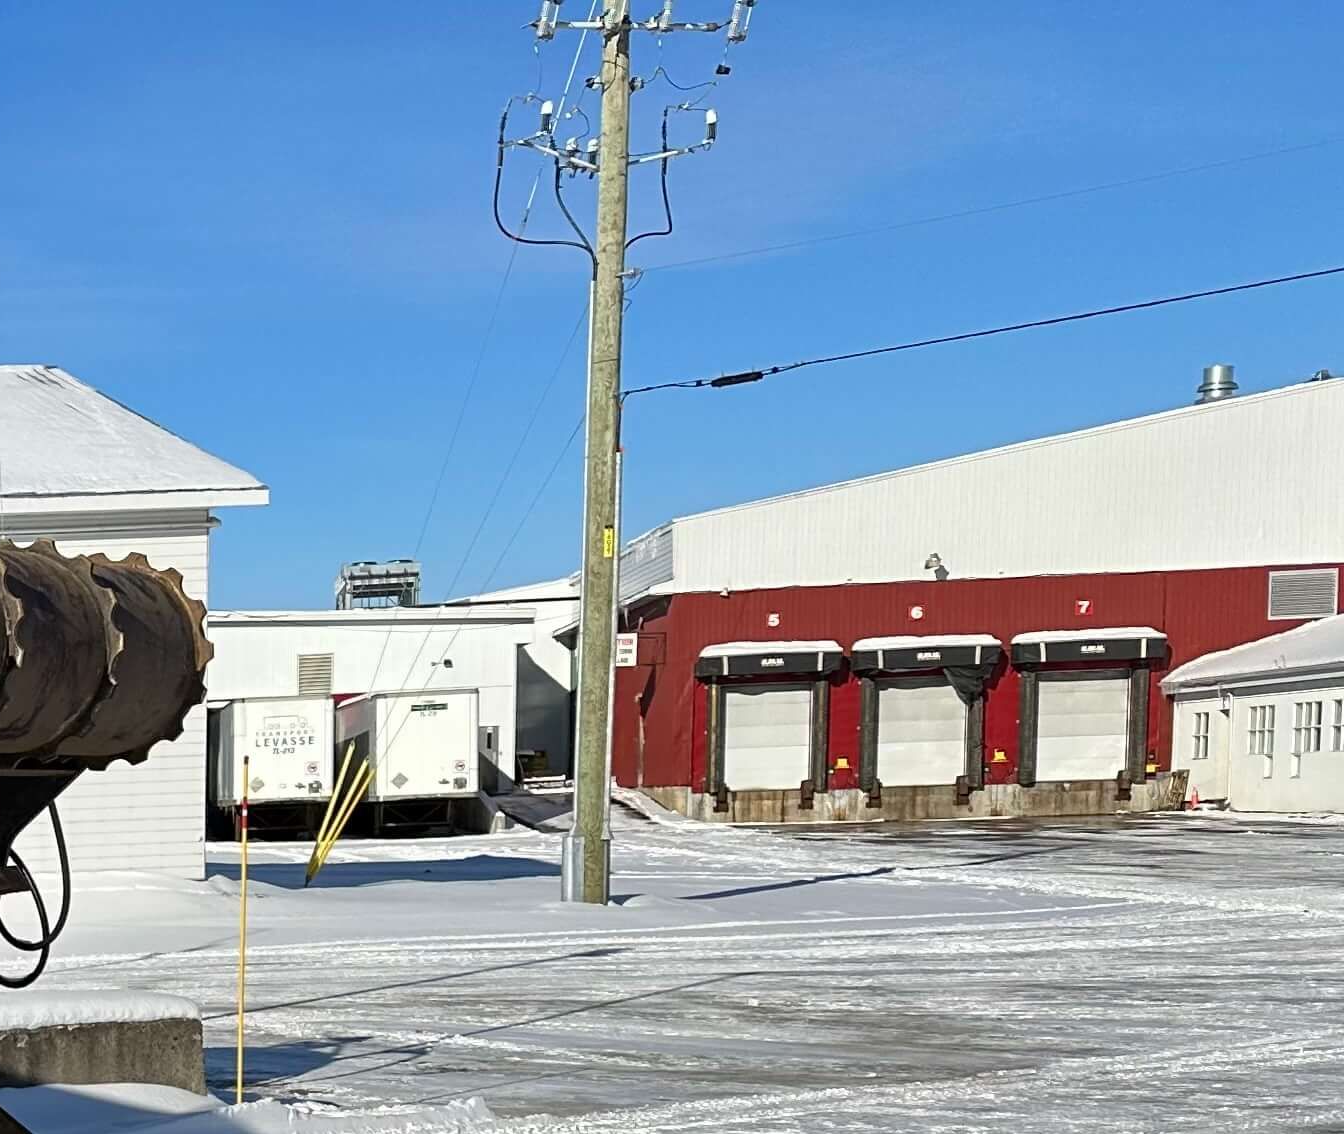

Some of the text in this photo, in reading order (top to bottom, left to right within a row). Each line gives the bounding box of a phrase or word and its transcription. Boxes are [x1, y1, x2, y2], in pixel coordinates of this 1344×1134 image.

[911, 606, 923, 619] 6
[1078, 600, 1090, 614] 7
[768, 613, 780, 627] 5
